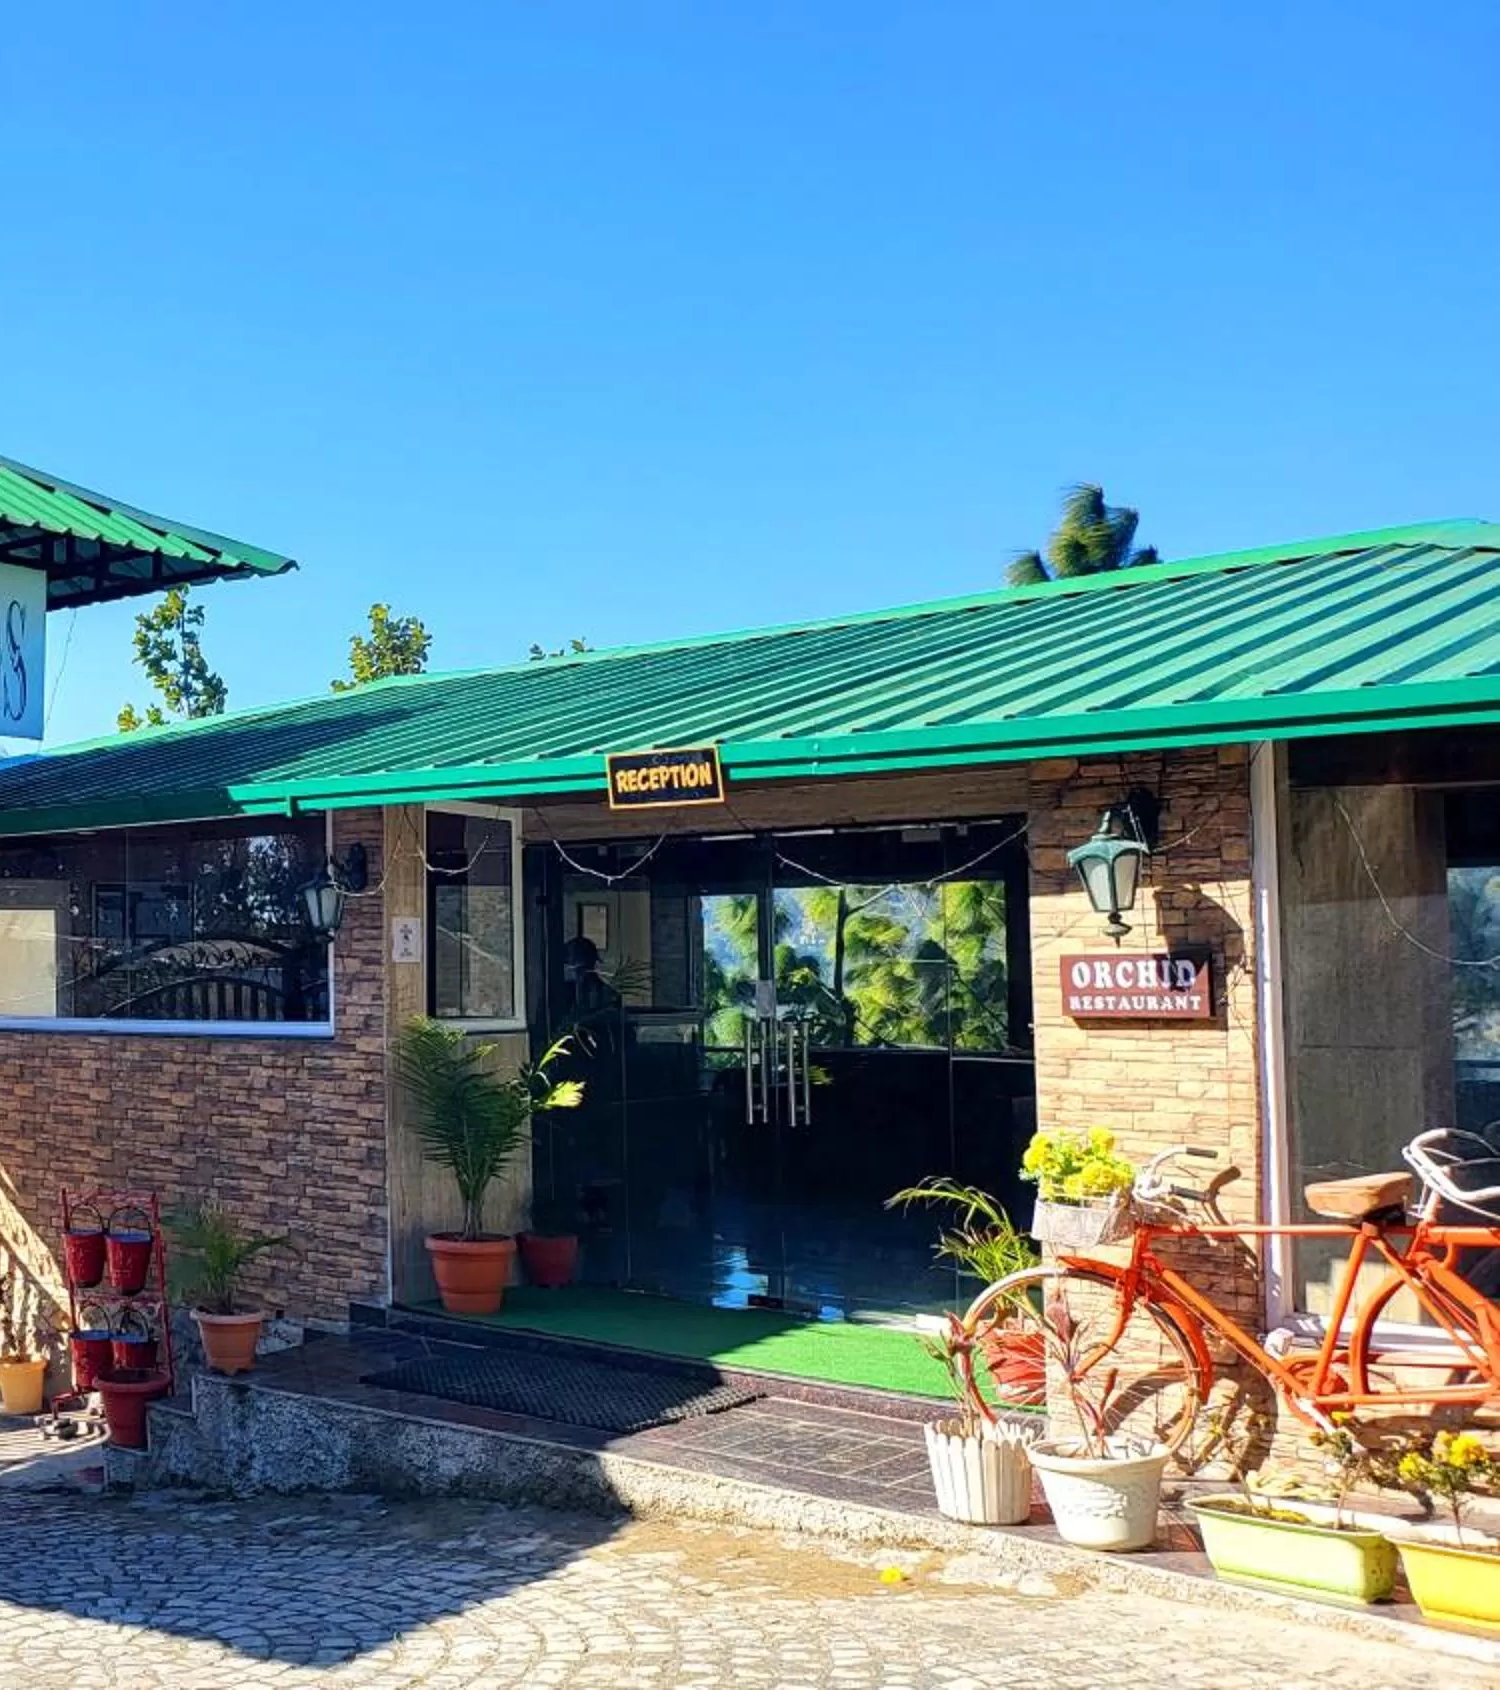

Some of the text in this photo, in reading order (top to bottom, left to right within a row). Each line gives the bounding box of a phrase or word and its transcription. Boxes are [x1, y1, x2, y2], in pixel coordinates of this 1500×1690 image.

[615, 761, 714, 794] RECEPTION
[1071, 959, 1197, 989] ORCHID
[1069, 995, 1202, 1011] RESTAURANT
